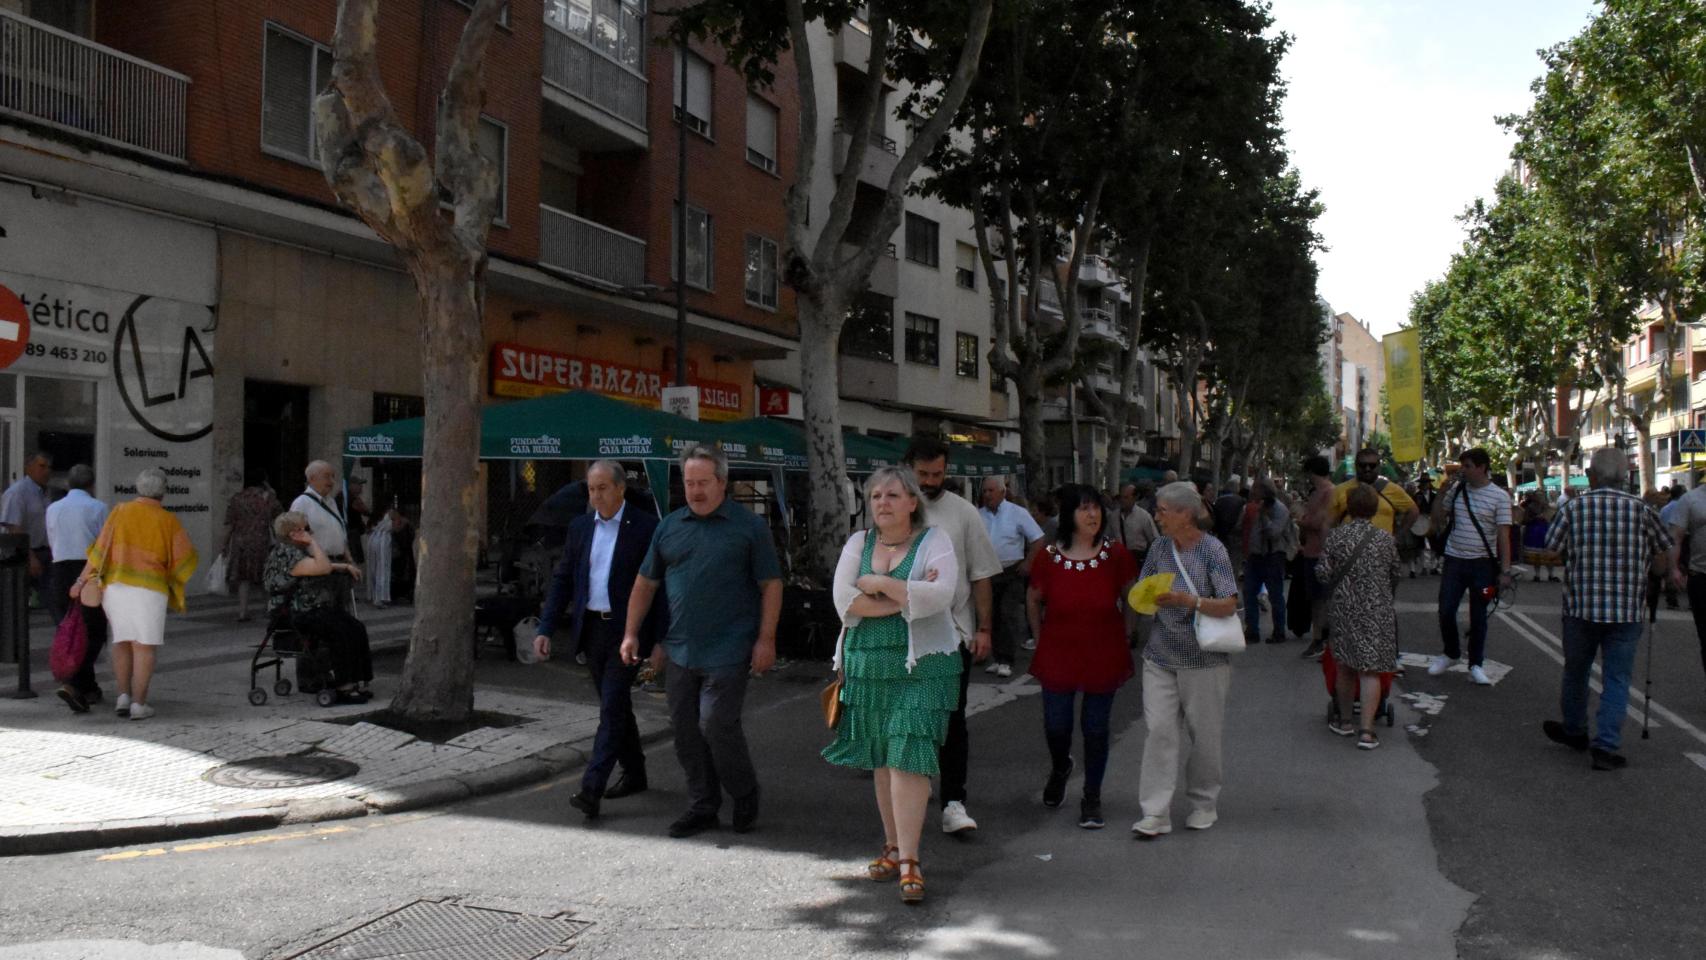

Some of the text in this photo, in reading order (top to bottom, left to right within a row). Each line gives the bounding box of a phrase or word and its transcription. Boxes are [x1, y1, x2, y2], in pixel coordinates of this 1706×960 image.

[21, 294, 109, 334] ética
[26, 343, 107, 364] 89 463 210
[501, 348, 661, 399] SUPER BAZAR
[704, 388, 739, 408] SIGLO
[124, 447, 168, 458] Solariums
[348, 443, 395, 452] CAJA RURAL
[510, 445, 561, 454] CAJA RURAL
[599, 445, 653, 454] CAJA RURAL
[114, 484, 137, 495] Medi
[162, 503, 209, 512] mentación
